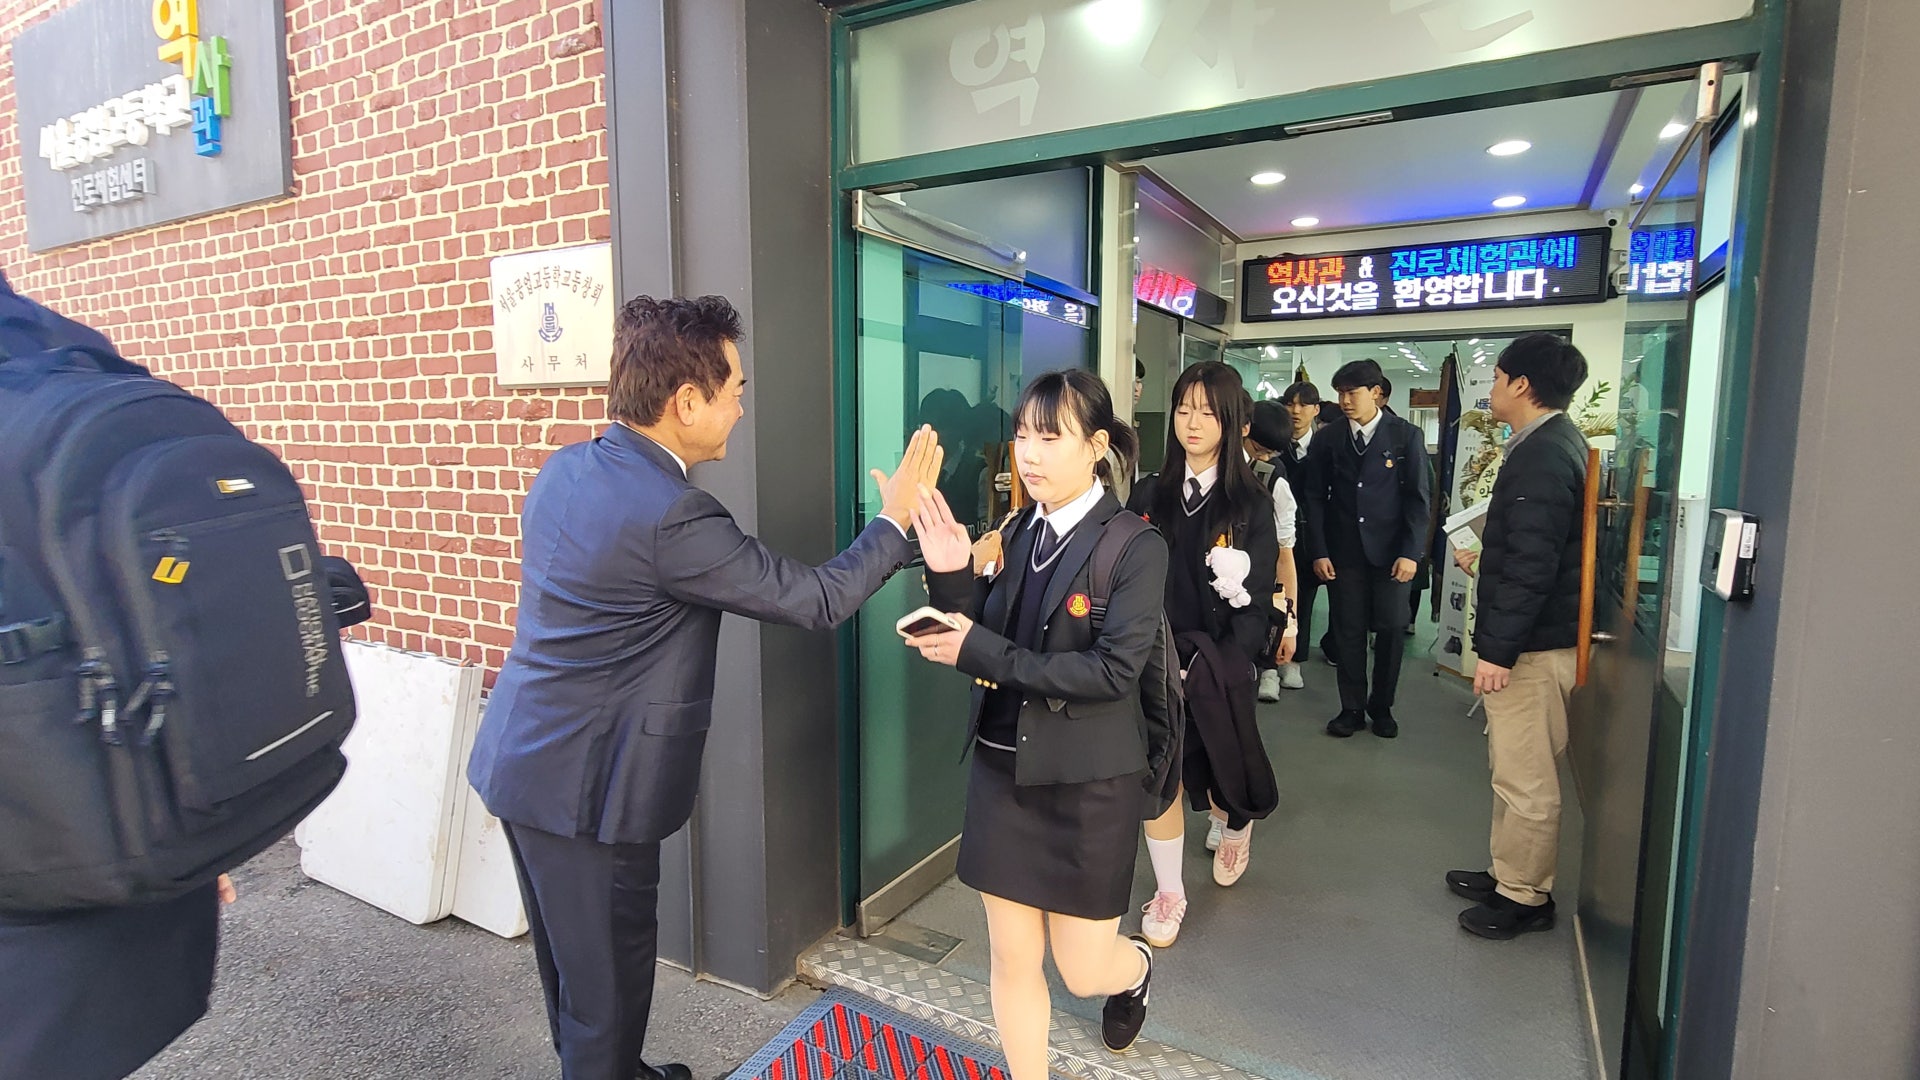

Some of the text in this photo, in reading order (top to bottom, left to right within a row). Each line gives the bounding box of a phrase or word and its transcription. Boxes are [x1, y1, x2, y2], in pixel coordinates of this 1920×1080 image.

[152, 0, 232, 157] 역사관
[71, 158, 155, 212] 진로체험센터
[1266, 236, 1578, 286] 역사관 & 진로체험관에
[1271, 268, 1562, 315] 오신것을 환영합니다.
